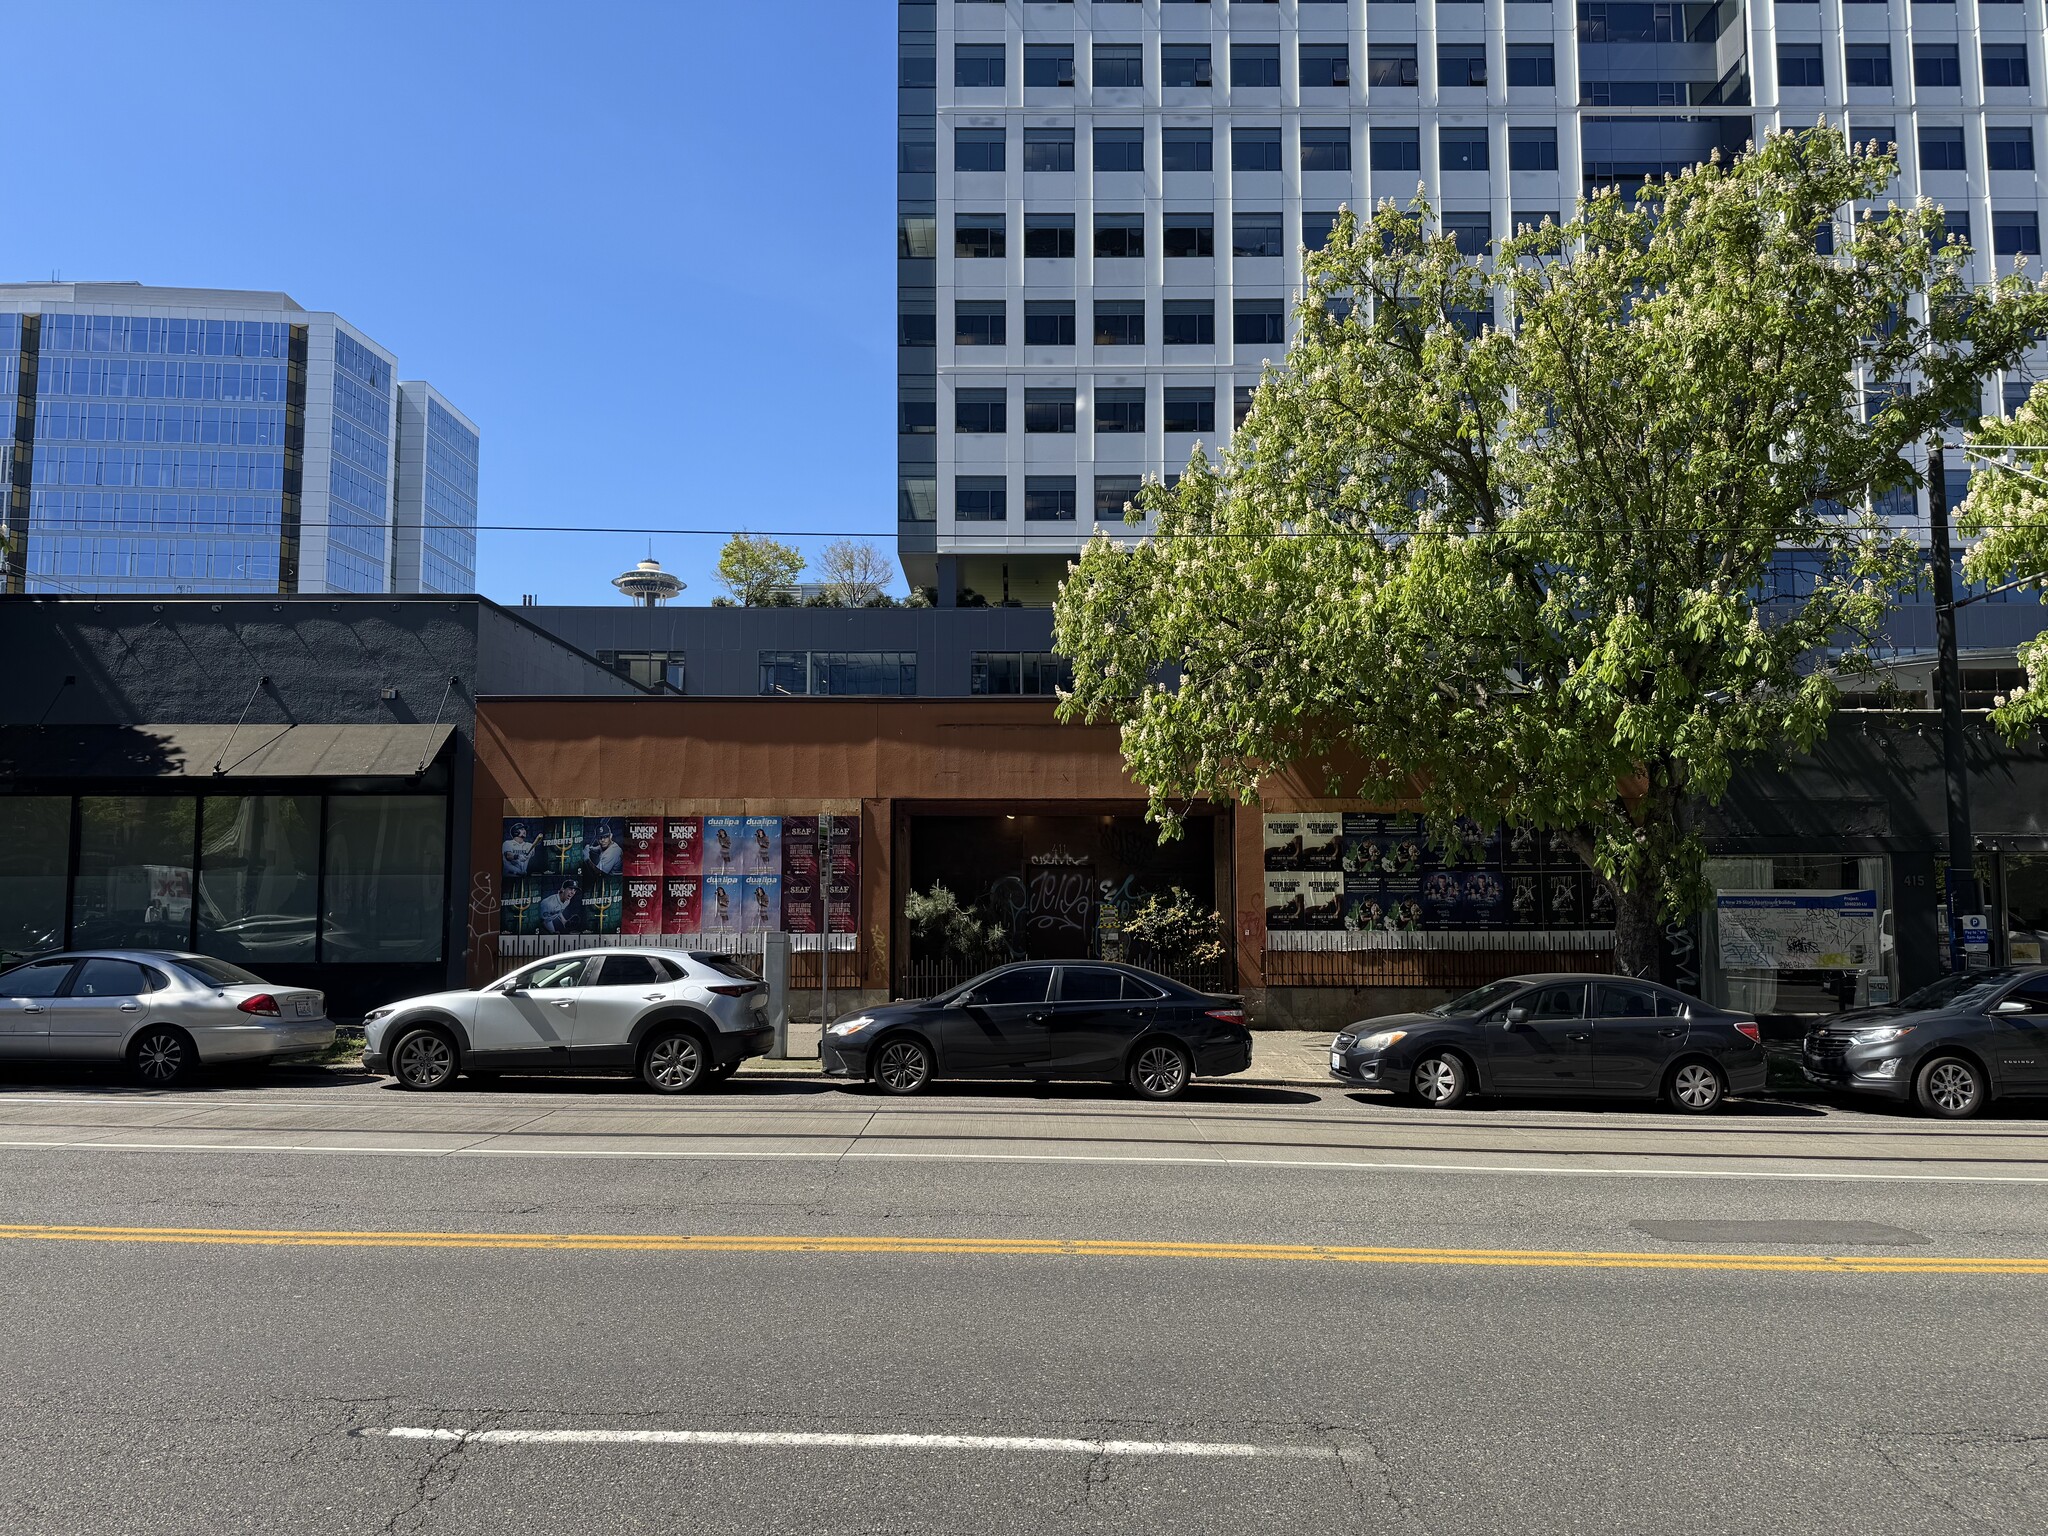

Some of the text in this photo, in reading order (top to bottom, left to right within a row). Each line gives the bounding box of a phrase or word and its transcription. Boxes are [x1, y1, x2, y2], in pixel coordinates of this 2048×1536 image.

[724, 818, 739, 826] lipa
[762, 818, 778, 826] lipa
[722, 876, 738, 885] lipa
[761, 876, 777, 885] lipa
[1904, 875, 1925, 886] 415
[829, 886, 849, 894] SEAF
[613, 895, 622, 903] UP
